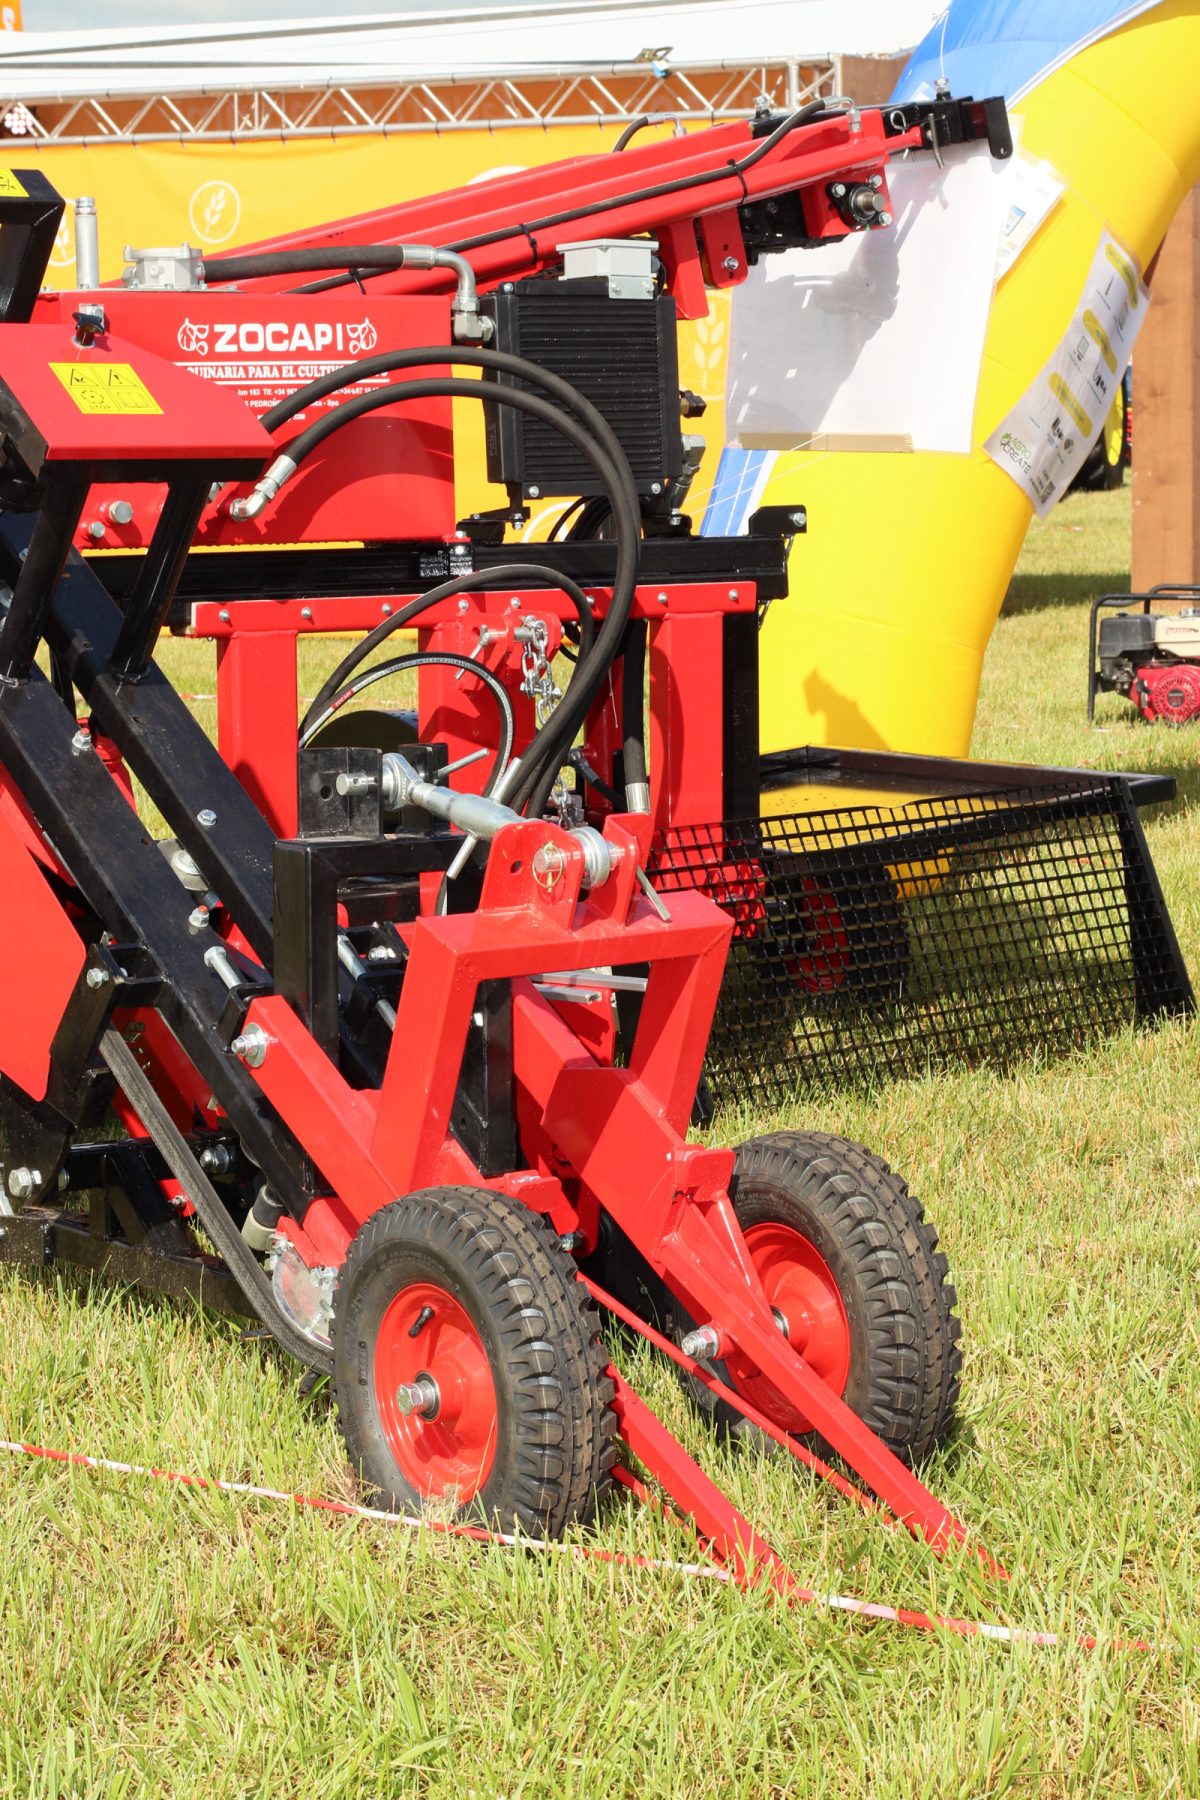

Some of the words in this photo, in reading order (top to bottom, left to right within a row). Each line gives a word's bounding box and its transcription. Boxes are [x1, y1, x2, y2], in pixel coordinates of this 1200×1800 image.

[214, 323, 343, 352] ZOCAPI
[187, 366, 247, 379] UINARIA
[248, 366, 280, 378] PARA
[281, 366, 296, 378] EL
[298, 365, 344, 378] CULTIV
[274, 388, 285, 396] +34
[1003, 444, 1032, 474] CREATE
[1010, 437, 1032, 459] AGRO
